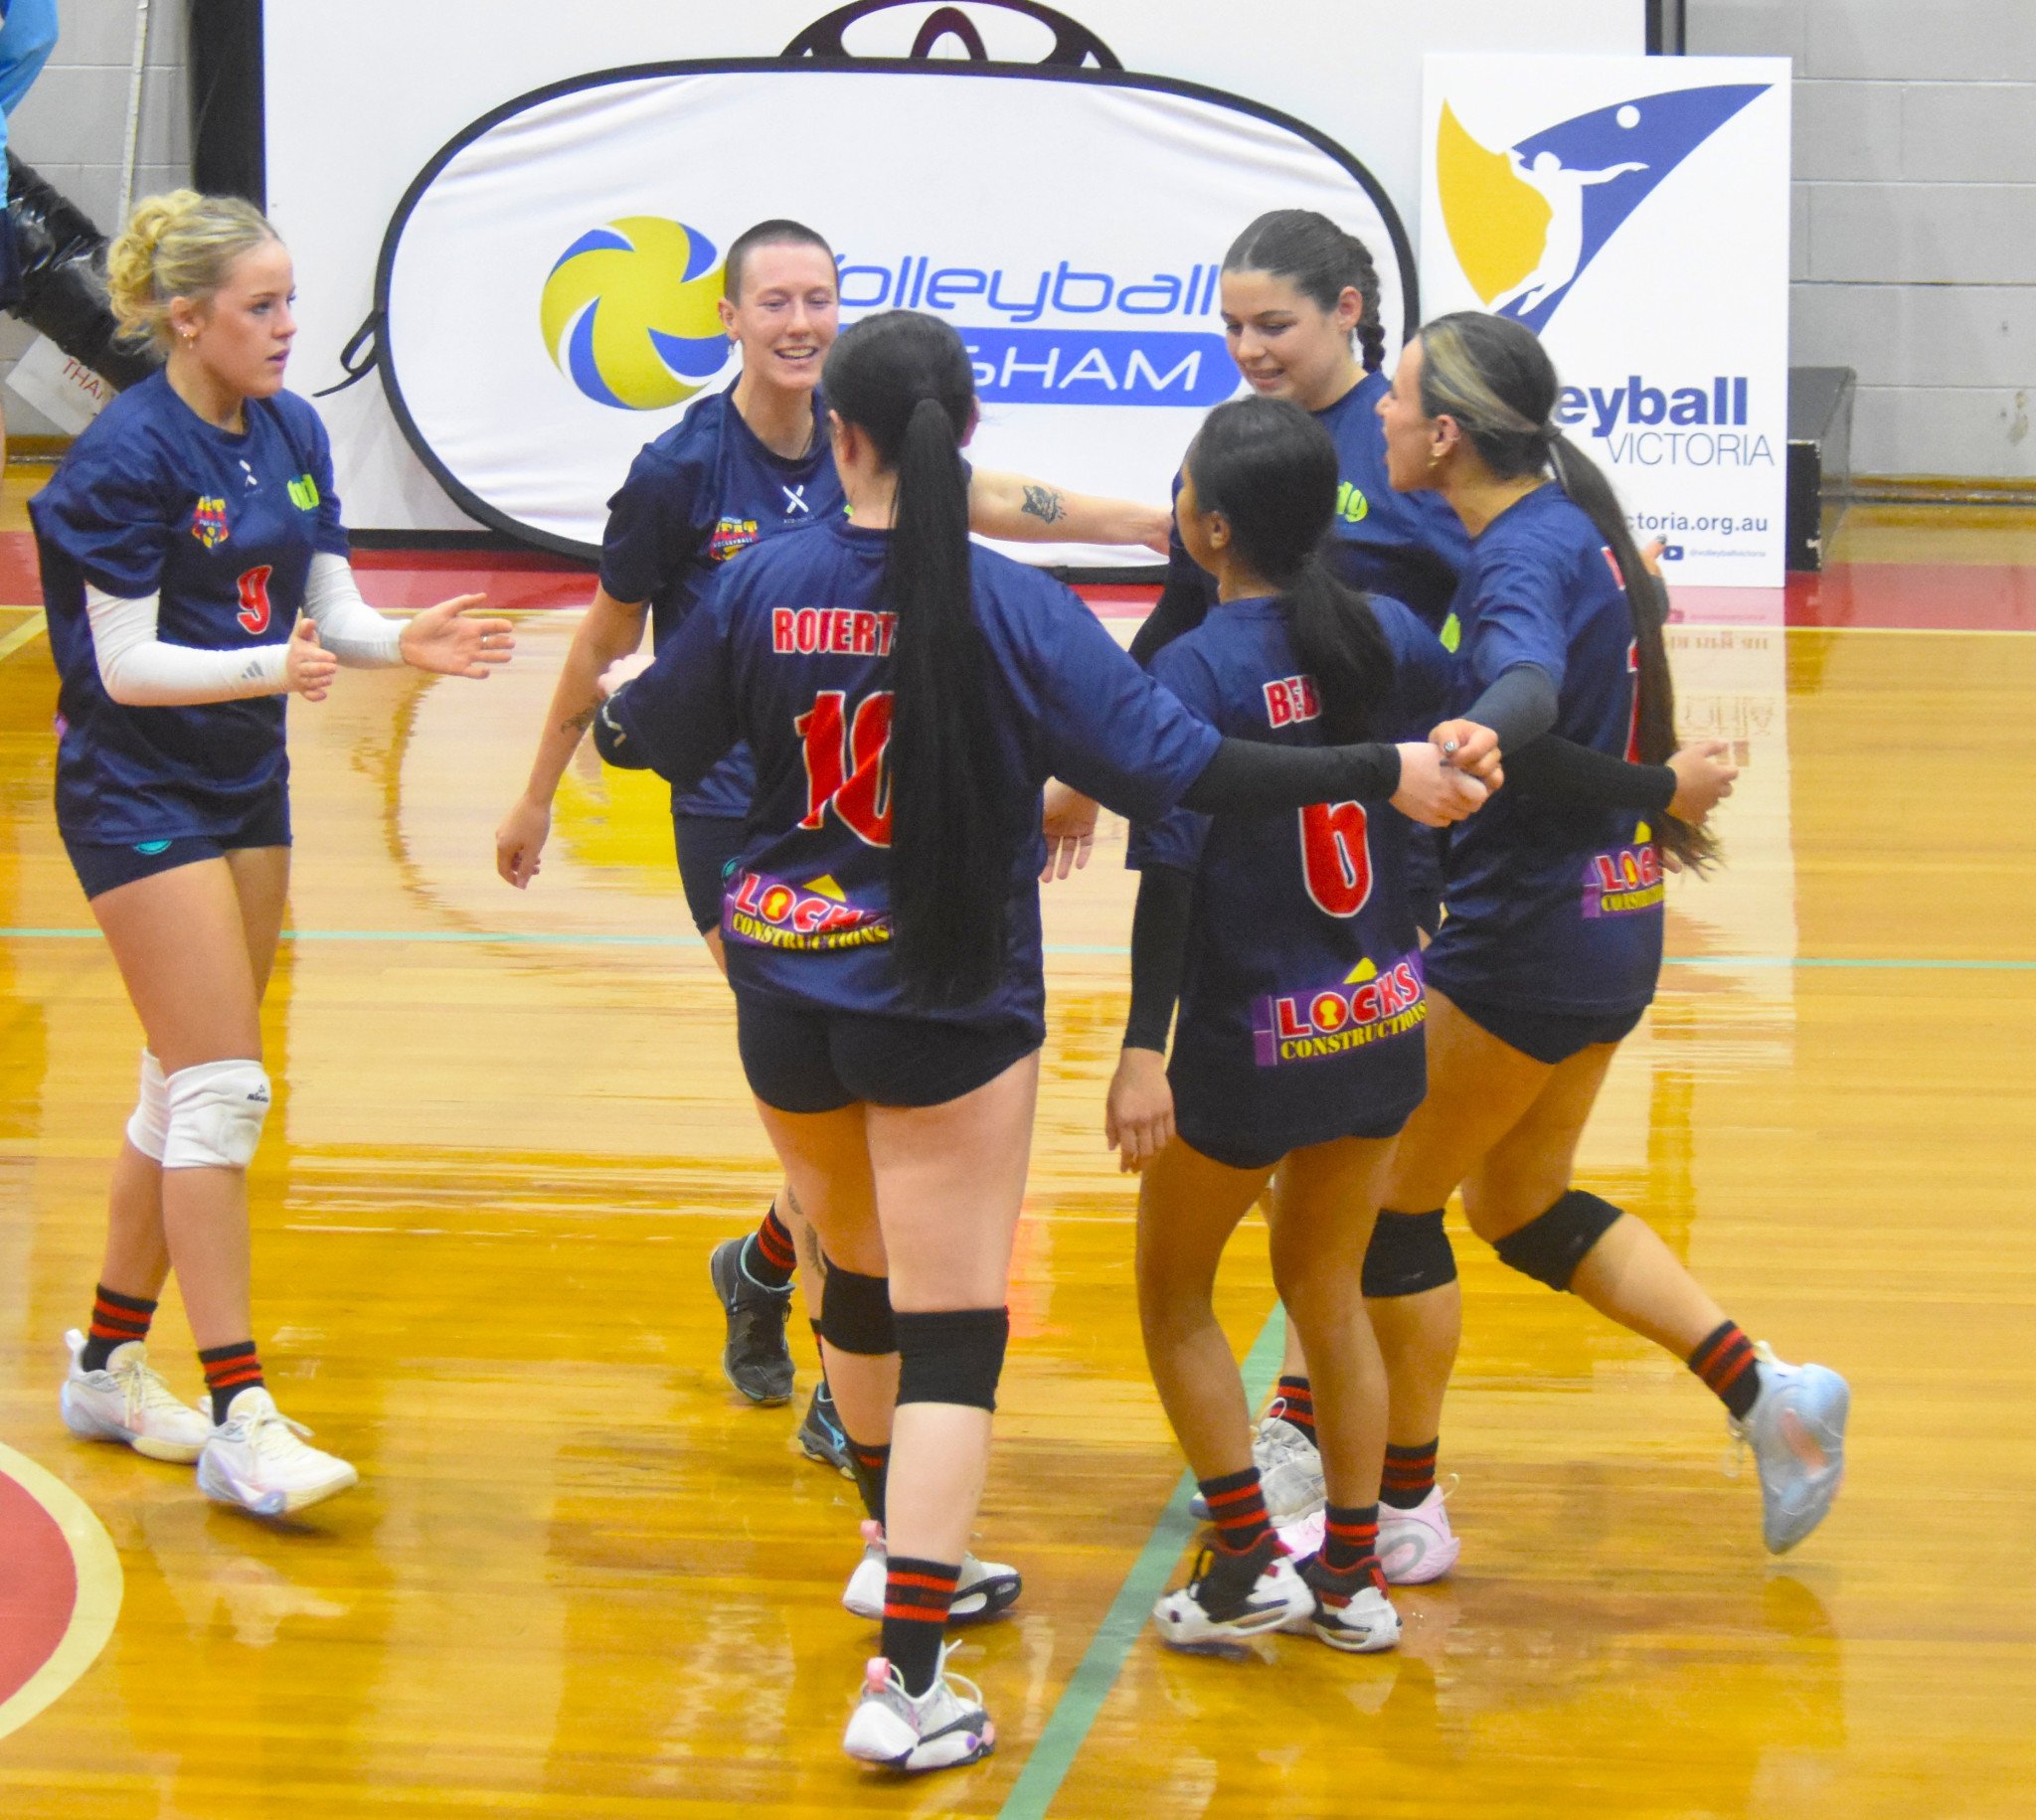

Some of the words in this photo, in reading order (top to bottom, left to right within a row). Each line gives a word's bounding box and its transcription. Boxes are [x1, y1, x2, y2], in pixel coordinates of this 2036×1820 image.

[835, 253, 1221, 323] olleyball
[1607, 432, 1775, 466] VICTORIA
[237, 565, 272, 634] 9
[772, 606, 899, 657] ROERT
[794, 690, 894, 848] 10
[1298, 800, 1373, 918] 6
[735, 873, 880, 933] LOCK
[1276, 962, 1421, 1039] LOCKS
[1280, 999, 1429, 1060] CONSTRUCTIONS
